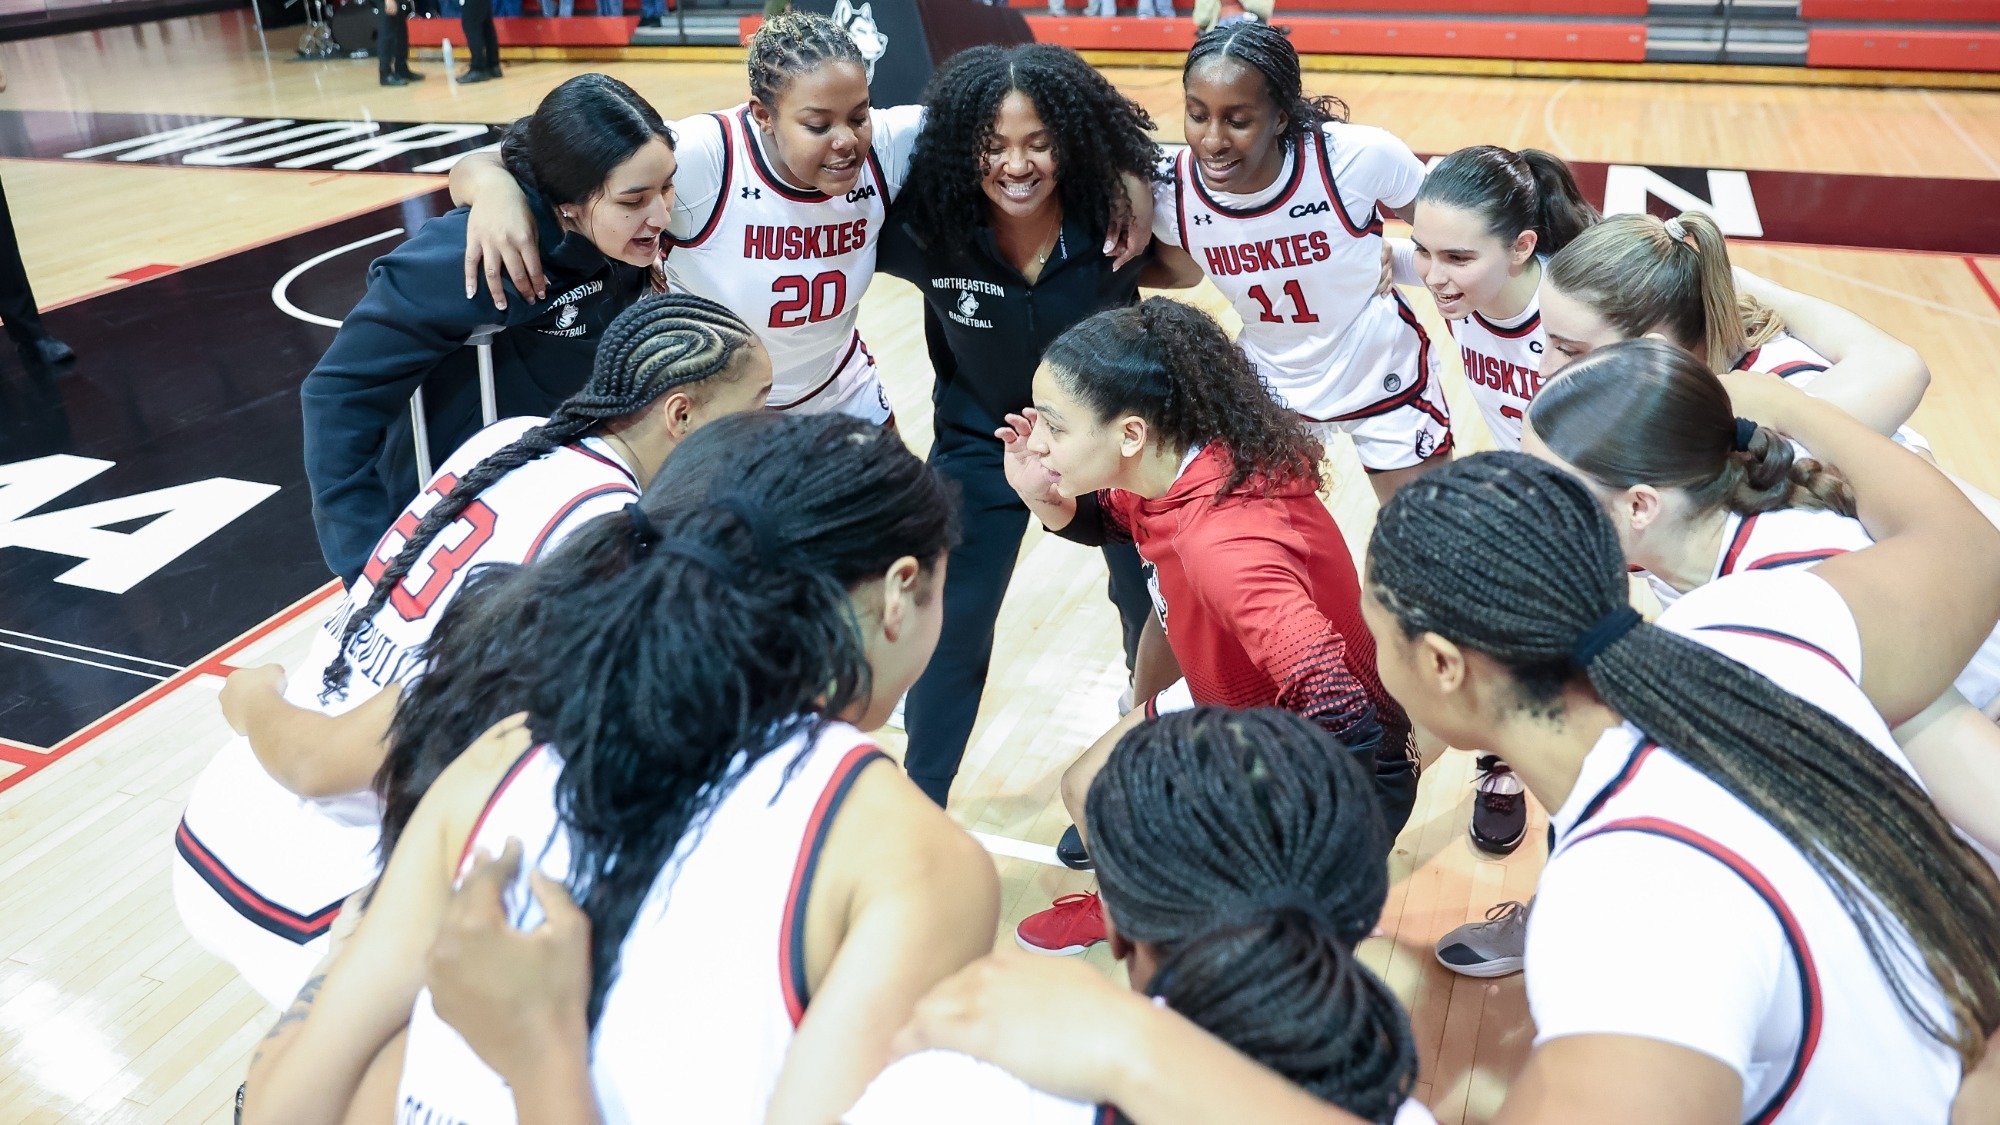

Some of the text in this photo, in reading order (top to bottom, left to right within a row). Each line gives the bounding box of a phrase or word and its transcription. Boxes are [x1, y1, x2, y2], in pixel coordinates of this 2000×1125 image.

[846, 184, 876, 203] CAA
[1289, 200, 1331, 218] CAA
[743, 218, 868, 260] HUSKIES
[1204, 230, 1331, 275] HUSKIES
[768, 269, 847, 328] 20
[931, 277, 1005, 298] NORTHEASTERN
[1248, 279, 1320, 324] 11
[948, 310, 994, 329] BASKETBALL
